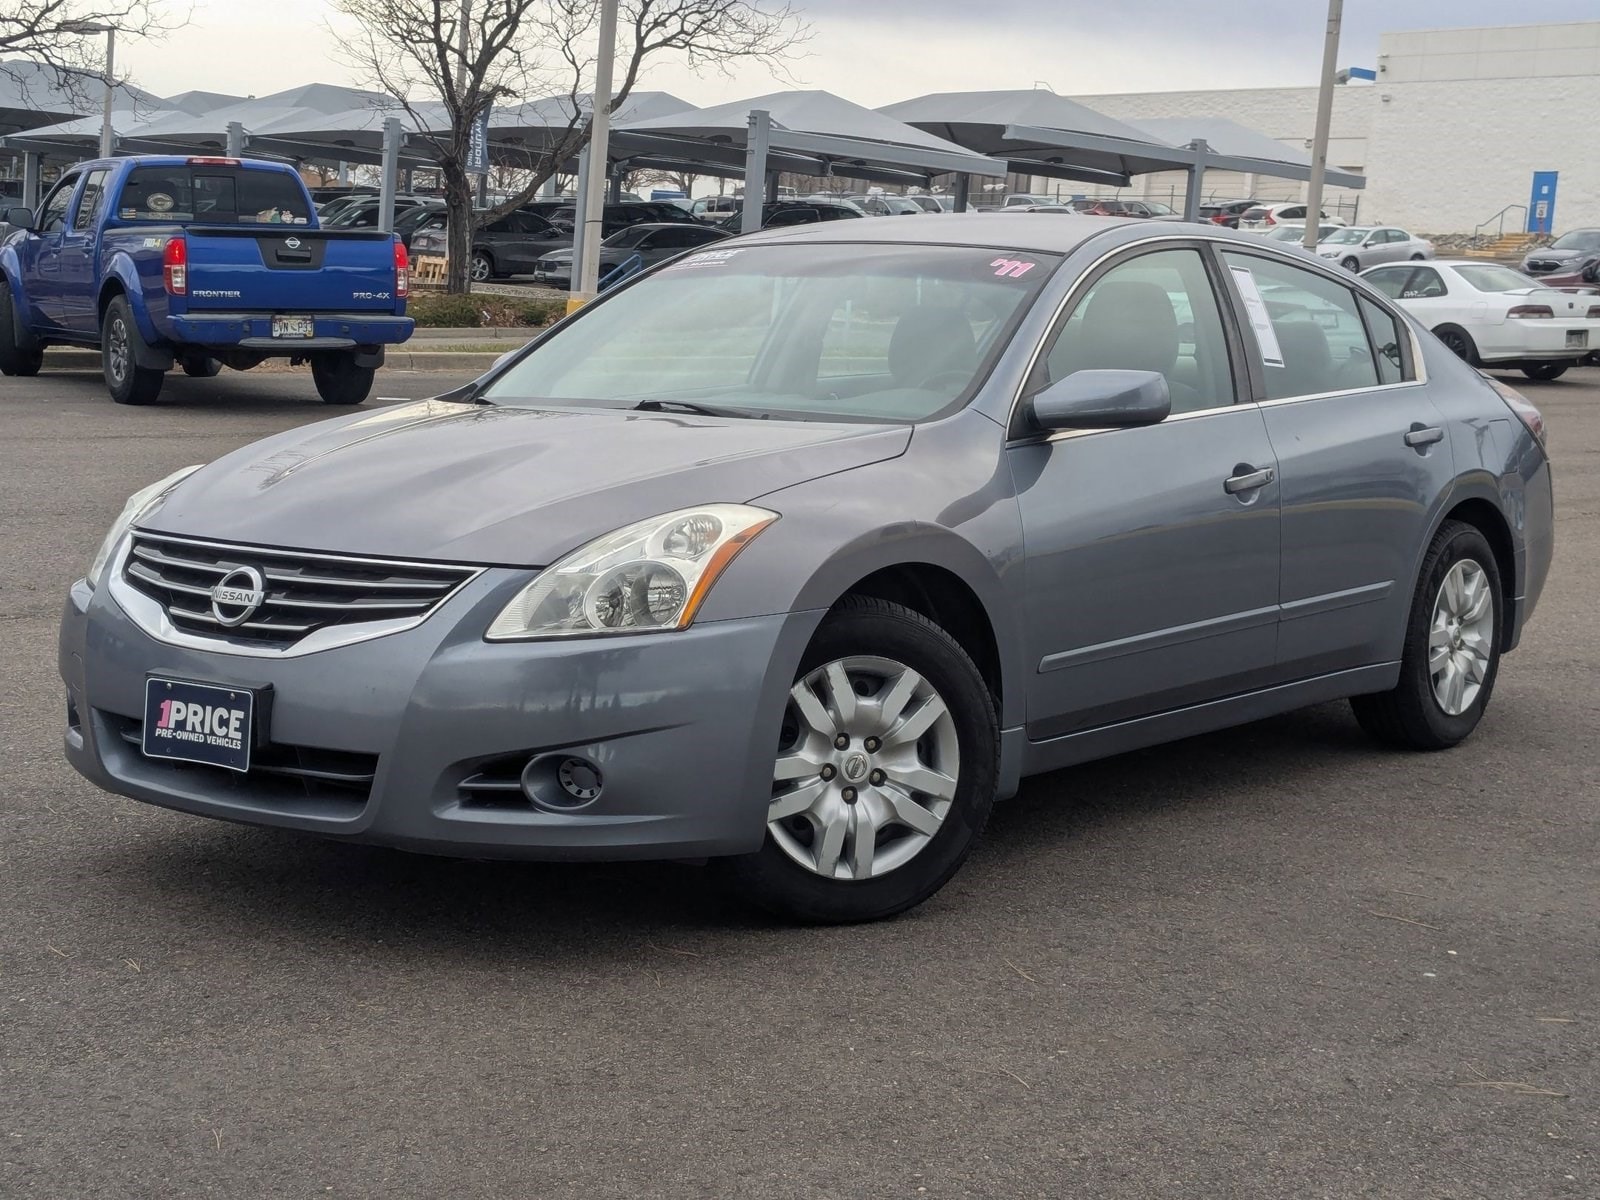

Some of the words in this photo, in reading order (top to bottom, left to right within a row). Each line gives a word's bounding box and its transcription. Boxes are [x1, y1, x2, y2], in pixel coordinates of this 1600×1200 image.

[192, 290, 241, 298] FRONTIER
[214, 589, 255, 603] NISSAN
[155, 728, 205, 743] PRE-OWNED
[206, 735, 242, 750] VEHICLES
